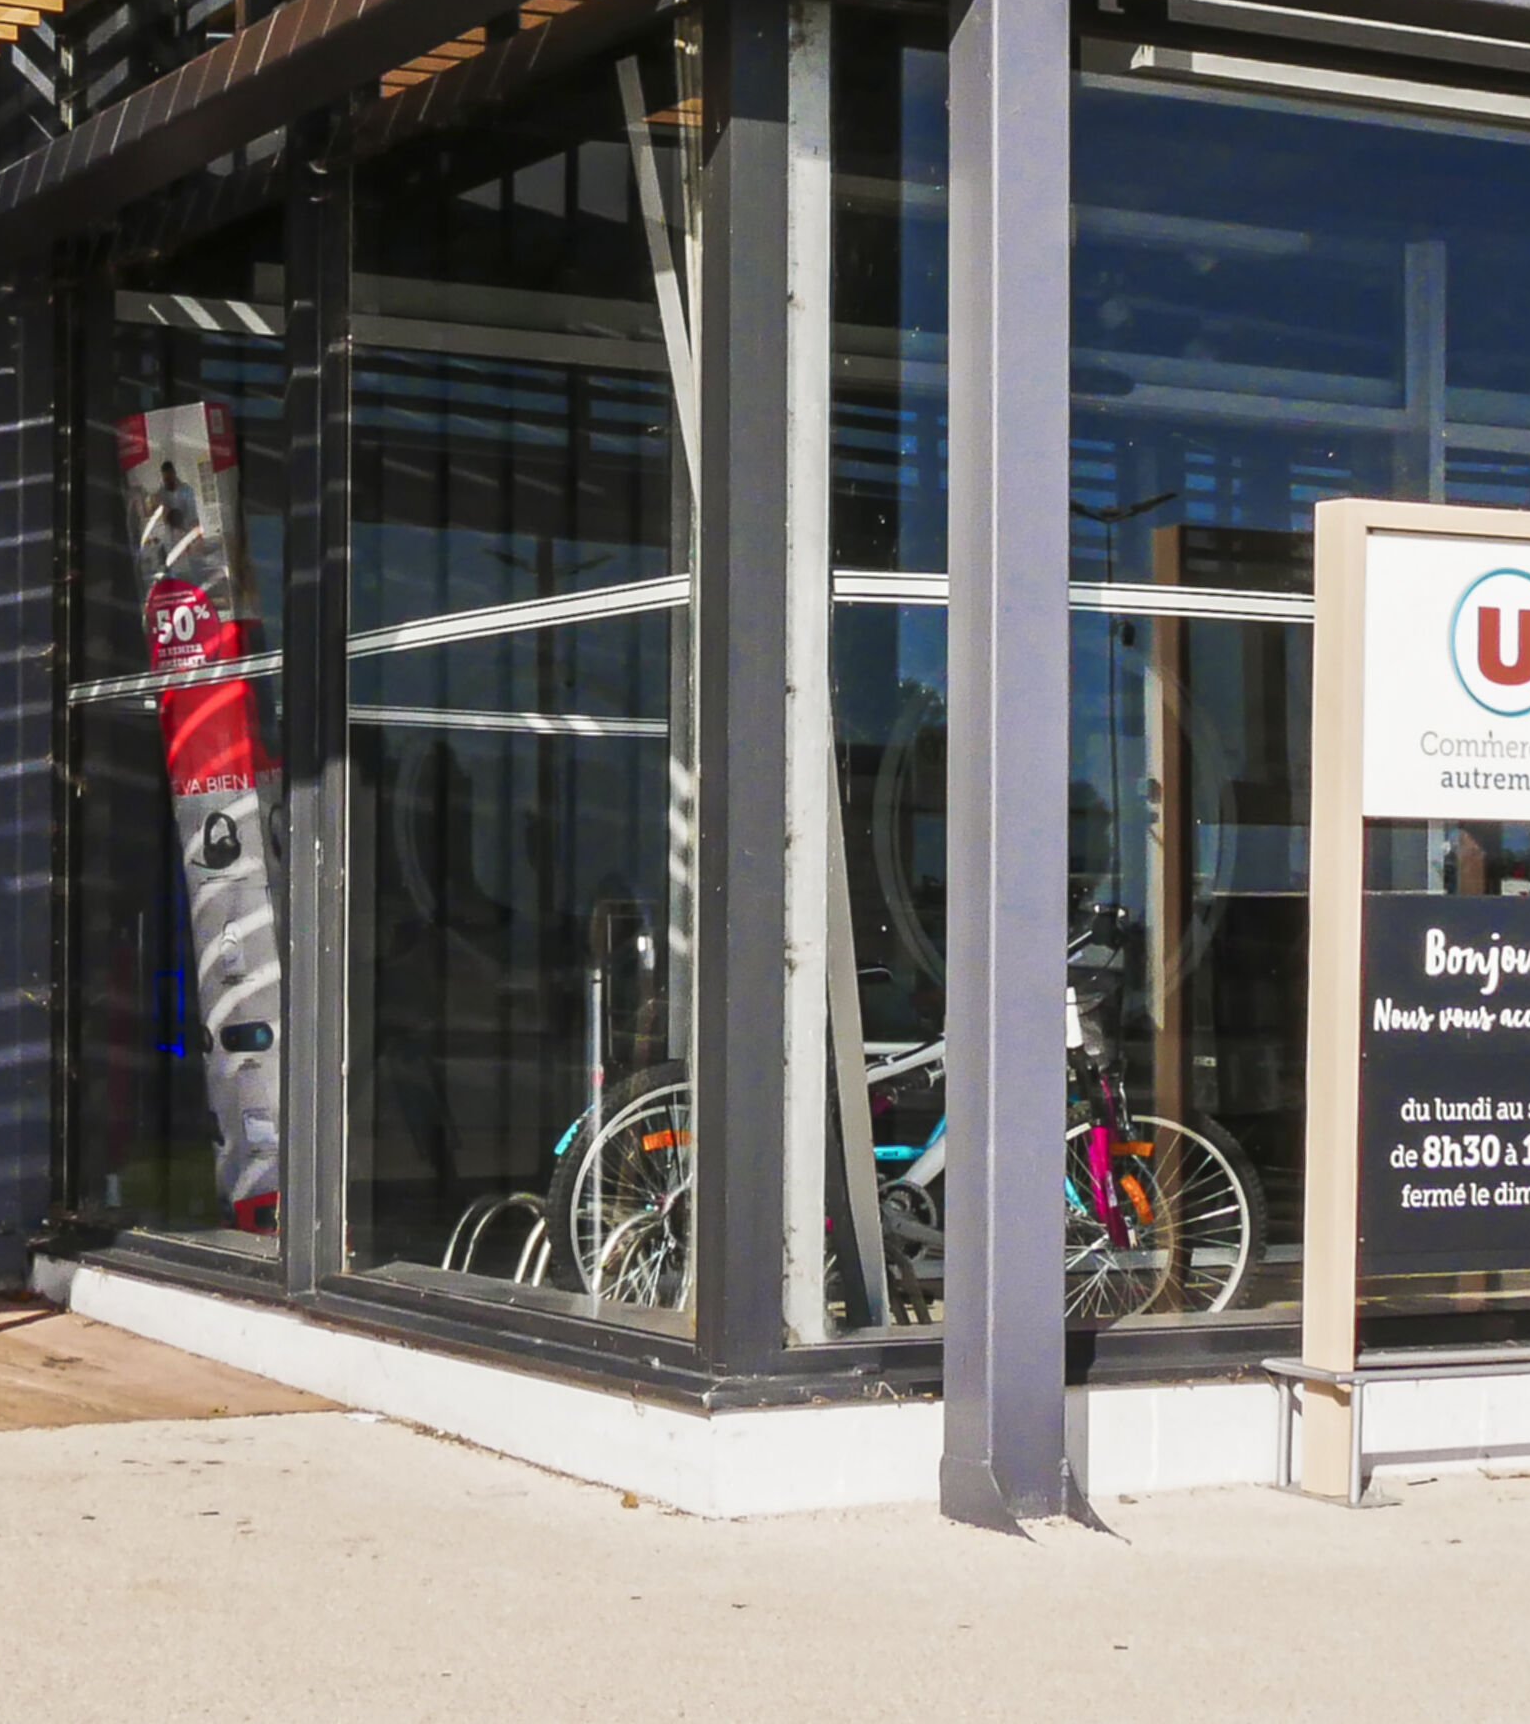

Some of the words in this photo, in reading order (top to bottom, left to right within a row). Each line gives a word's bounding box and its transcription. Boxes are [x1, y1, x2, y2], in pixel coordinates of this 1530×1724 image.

[206, 773, 248, 793] BIEN
[1373, 998, 1435, 1031] Nous
[1439, 1002, 1496, 1032] vous
[1400, 1098, 1430, 1122] du
[1435, 1097, 1492, 1121] lundi
[1496, 1100, 1523, 1120] au
[1390, 1145, 1418, 1168] de
[1422, 1134, 1501, 1168] 8h30
[1504, 1142, 1518, 1165] à
[1401, 1183, 1466, 1208] fermé
[1469, 1182, 1490, 1206] le
